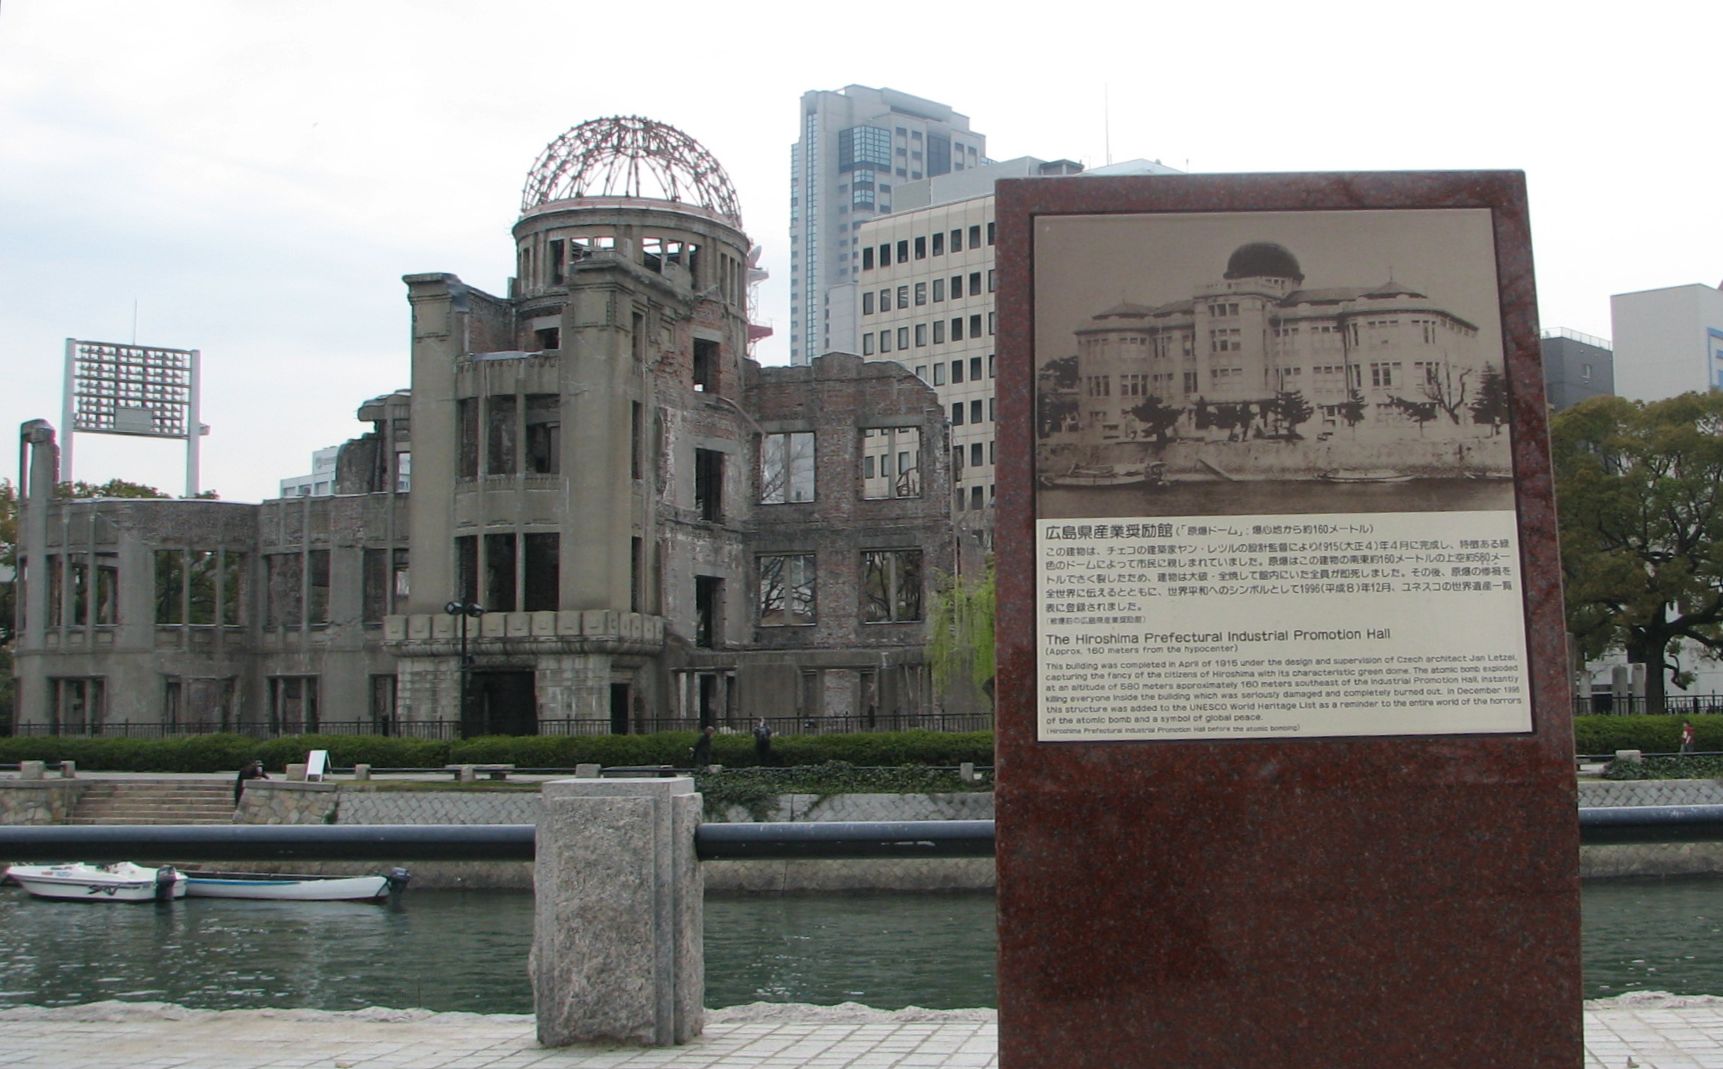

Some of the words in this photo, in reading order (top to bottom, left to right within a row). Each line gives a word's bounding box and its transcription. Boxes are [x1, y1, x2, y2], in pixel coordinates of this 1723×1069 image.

[1045, 523, 1173, 540] 広島県産業奨励館
[1045, 633, 1070, 645] The
[1075, 633, 1139, 644] Hiroshima
[1144, 632, 1222, 643] Prefectural
[1228, 630, 1288, 642] Industrial
[1293, 629, 1361, 640] Promotion
[1366, 629, 1390, 640] Hall
[1087, 646, 1104, 655] 160
[1107, 645, 1139, 654] meters
[1142, 645, 1163, 654] from
[1166, 644, 1181, 654] the
[1046, 661, 1063, 670] This
[1065, 661, 1098, 671] building
[1120, 660, 1166, 670] completed
[1168, 659, 1176, 668] in
[1178, 659, 1199, 669] April
[1201, 659, 1212, 668] of
[1215, 658, 1238, 667] 1915
[1240, 658, 1265, 667] under
[1267, 658, 1282, 667] the
[1284, 657, 1313, 667] design
[1315, 657, 1331, 666] and
[1333, 656, 1382, 666] supervision
[1384, 656, 1394, 665] of
[1396, 655, 1423, 664] Czech
[1425, 655, 1467, 664] architect
[1468, 654, 1486, 663] Jan
[1045, 673, 1088, 682] capturing
[1090, 672, 1105, 680] the
[1107, 672, 1132, 681] fancy
[1134, 672, 1144, 680] of
[1147, 671, 1162, 679] the
[1164, 671, 1197, 679] citizens
[1200, 670, 1210, 678] of
[1212, 670, 1255, 678] Hiroshima
[1257, 669, 1276, 677] with
[1278, 669, 1290, 677] its
[1292, 668, 1355, 676] characteristic
[1412, 666, 1428, 674] The
[1430, 666, 1458, 674] atomic
[1460, 665, 1480, 673] bomb
[1482, 665, 1518, 674] exploded
[1045, 684, 1056, 692] at
[1071, 683, 1106, 691] altitude
[1108, 683, 1118, 691] of
[1120, 682, 1140, 690] 580
[1142, 682, 1174, 690] meters
[1176, 681, 1238, 690] approximately
[1240, 680, 1259, 688] 160
[1260, 680, 1292, 688] meters
[1294, 679, 1339, 687] southeast
[1341, 679, 1350, 687] of
[1354, 678, 1368, 686] the
[1370, 678, 1411, 686] Industrial
[1413, 677, 1458, 685] Promotion
[1481, 676, 1518, 685] instantly
[1045, 694, 1068, 704] killing
[1070, 695, 1110, 703] everyone
[1112, 693, 1138, 702] inside
[1140, 693, 1155, 701] the
[1157, 692, 1190, 702] building
[1193, 692, 1218, 700] which
[1241, 691, 1280, 700] seriously
[1282, 690, 1322, 700] damaged
[1324, 689, 1340, 698] and
[1343, 689, 1391, 698] completely
[1394, 688, 1424, 696] burned
[1447, 687, 1454, 696] In
[1456, 687, 1501, 695] December
[1046, 705, 1062, 714] this
[1065, 705, 1108, 713] structure
[1130, 704, 1157, 712] added
[1160, 703, 1170, 712] to
[1172, 703, 1187, 711] the
[1189, 703, 1227, 711] UNESCO
[1229, 702, 1255, 710] World
[1257, 701, 1296, 710] Heritage
[1298, 701, 1316, 709] List
[1046, 716, 1056, 725] of
[1058, 716, 1073, 725] the
[1076, 716, 1105, 724] atomic
[1108, 715, 1132, 724] bomb
[1134, 715, 1150, 723] and
[1160, 714, 1190, 724] symbol
[1192, 714, 1203, 722] of
[1204, 714, 1231, 723] global
